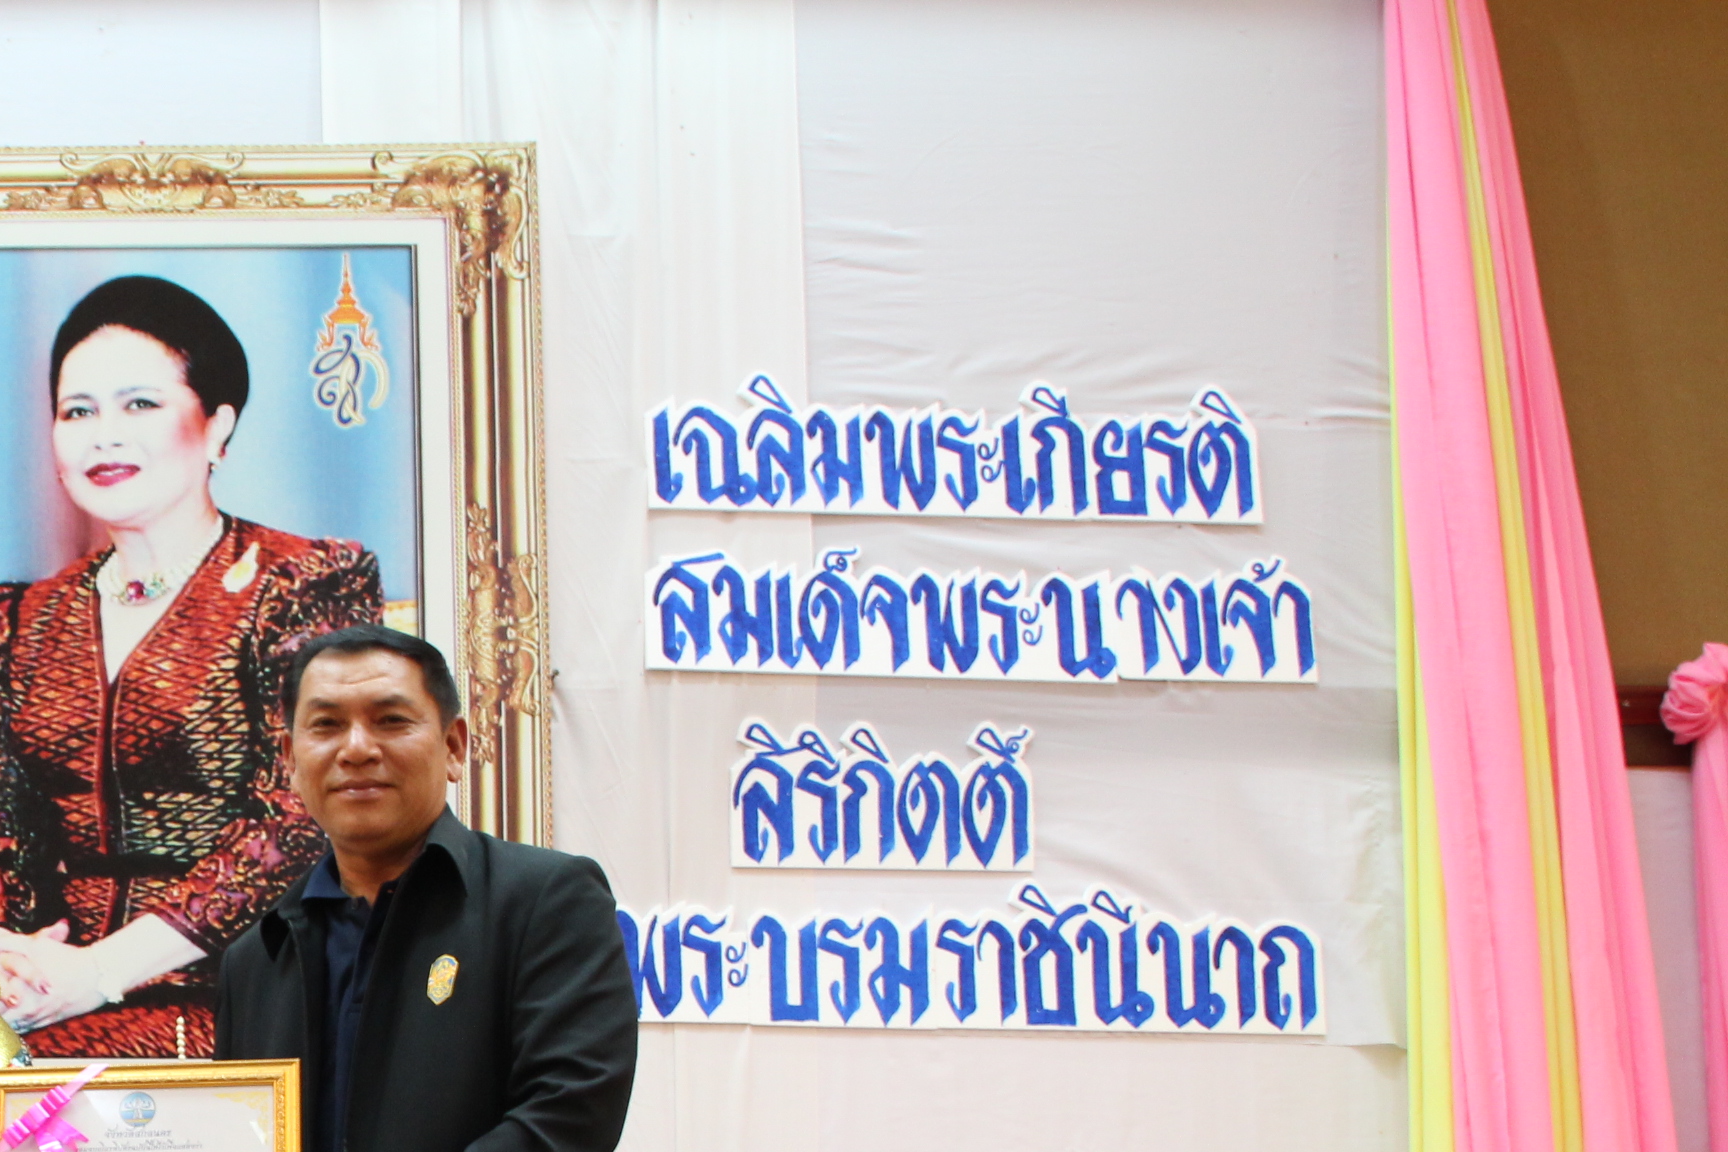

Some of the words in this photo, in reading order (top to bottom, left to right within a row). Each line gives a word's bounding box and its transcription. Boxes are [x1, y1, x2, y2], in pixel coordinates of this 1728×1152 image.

[652, 374, 1256, 517] เฉลิมพระเกียรติ
[653, 548, 1316, 680] สมเด็จพระนางเจ้า
[733, 723, 1030, 868] สิริกิตติ์
[615, 884, 1320, 1031] พระบรมราชินีนาถ
